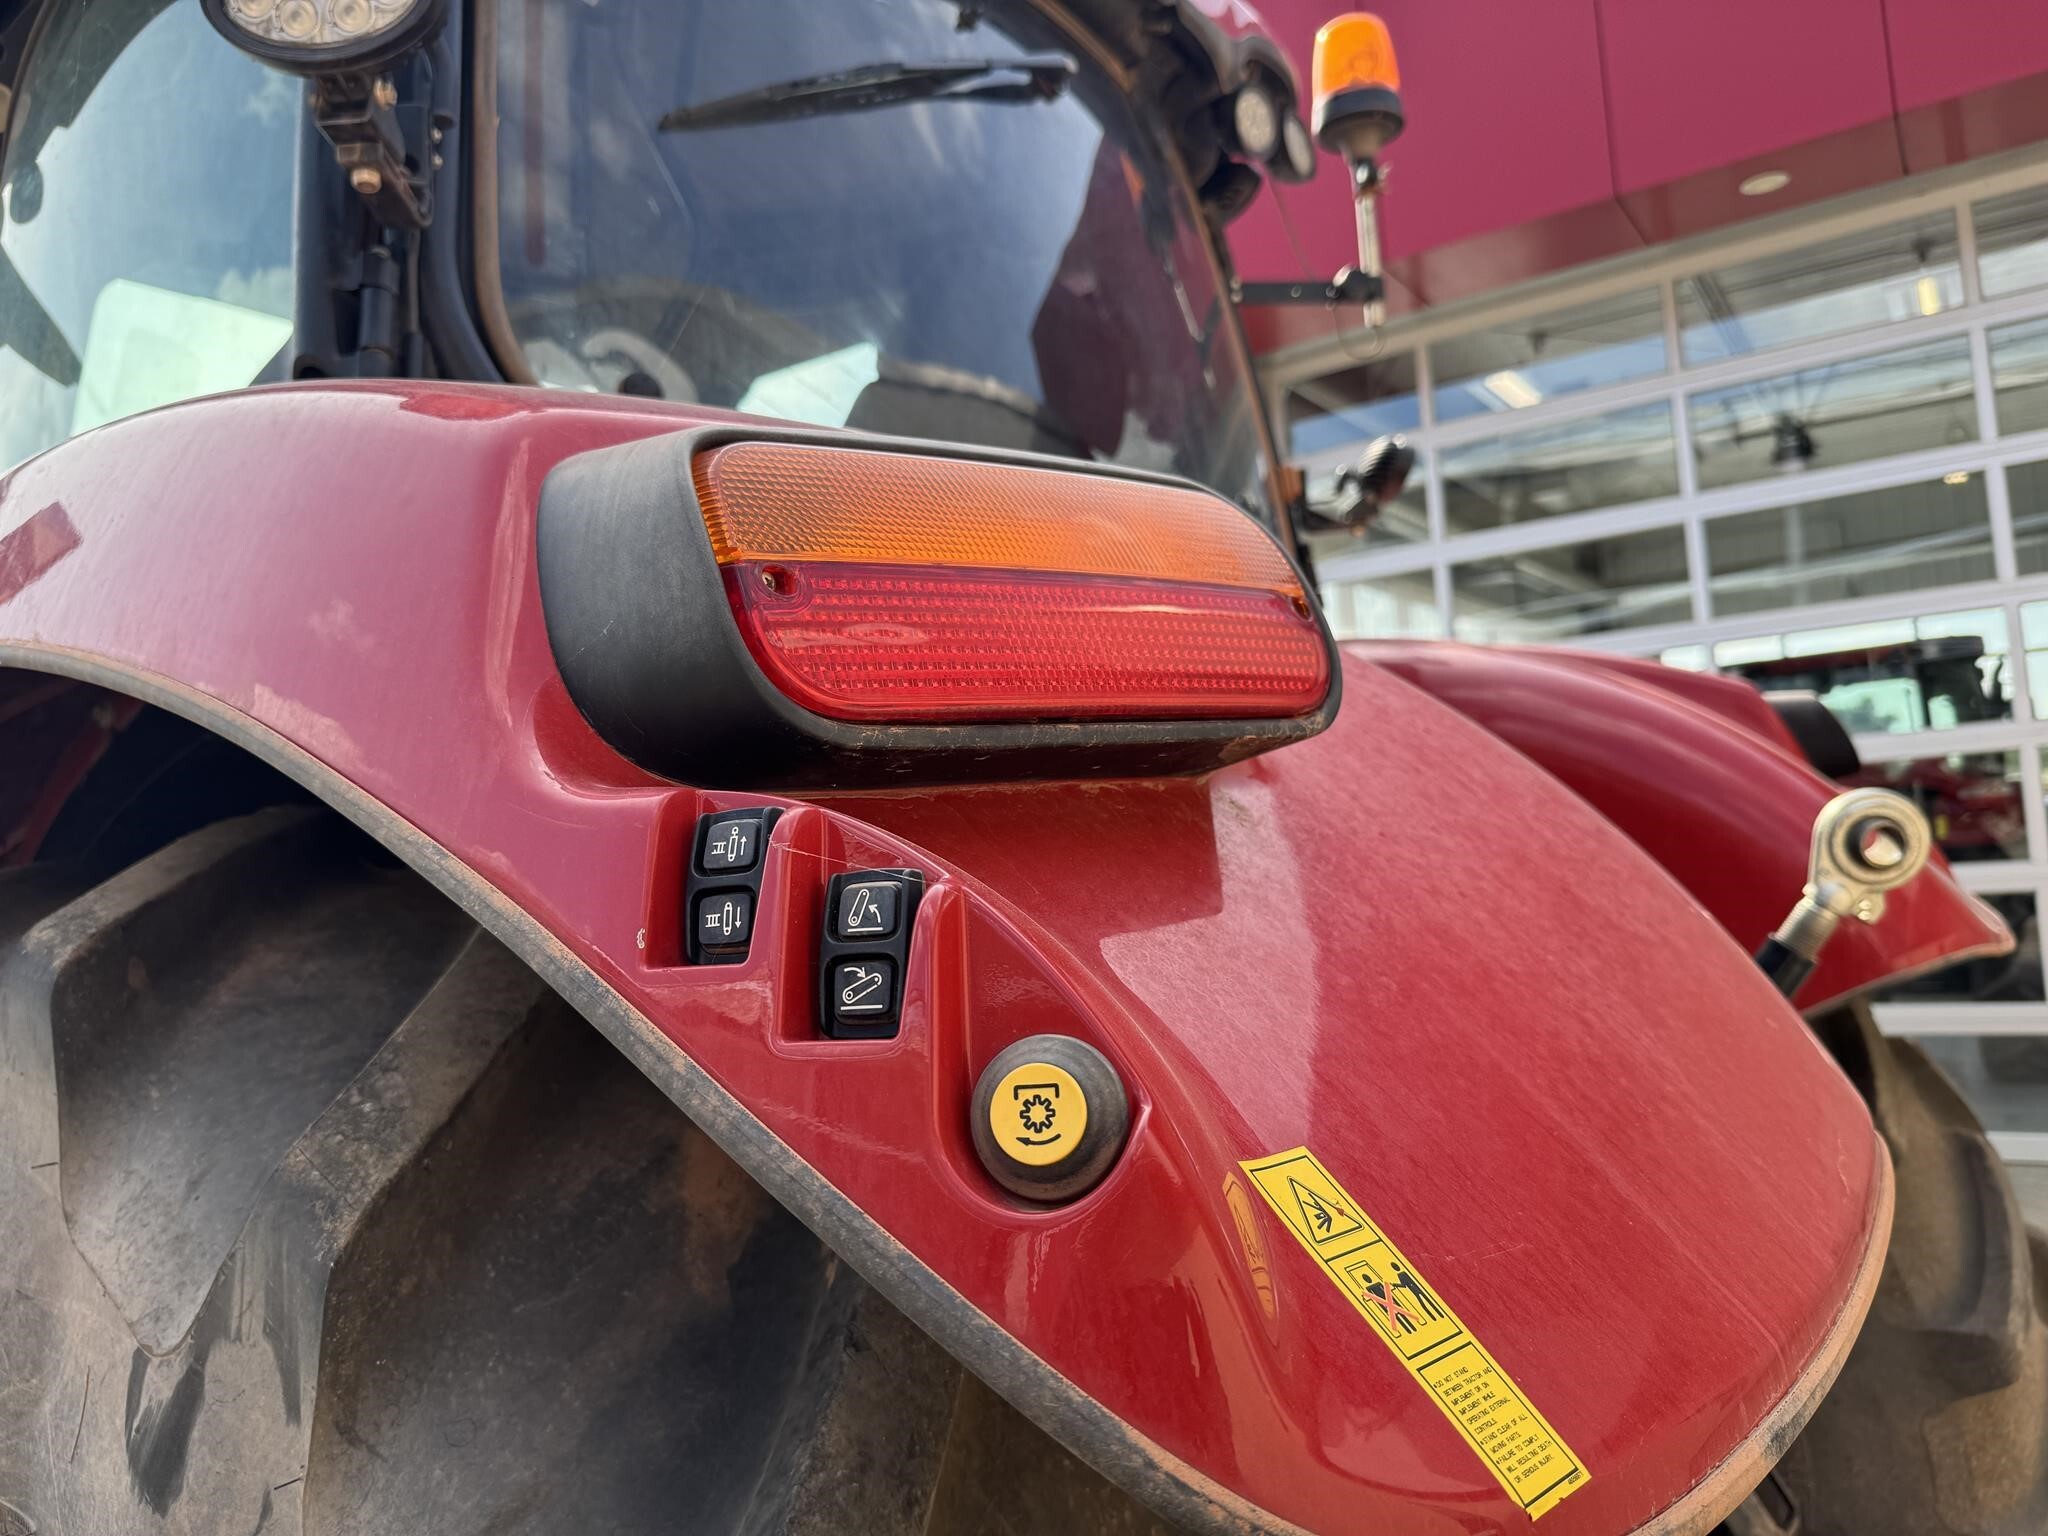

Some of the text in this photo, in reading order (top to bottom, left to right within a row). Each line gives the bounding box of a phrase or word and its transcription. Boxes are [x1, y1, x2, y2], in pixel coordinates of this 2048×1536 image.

[1436, 1367, 1468, 1388] DO NOT STAND
[1443, 1383, 1464, 1397] BETWEEN
[1463, 1372, 1483, 1385] TRACTOR
[1451, 1389, 1474, 1406] IMPLEMENT
[1459, 1391, 1496, 1415] IMPLEMENT WHILE
[1467, 1398, 1510, 1425] OPERATING EXTERNAL
[1482, 1432, 1497, 1444] STAND
[1497, 1423, 1512, 1434] CLEAR
[1511, 1418, 1517, 1426] OF
[1498, 1434, 1539, 1463] FAILURE TO COMPLY
[1506, 1464, 1518, 1473] WILL
[1538, 1441, 1552, 1452] DEATH
[1514, 1475, 1523, 1483] OR
[1521, 1464, 1539, 1478] SERIOUS
